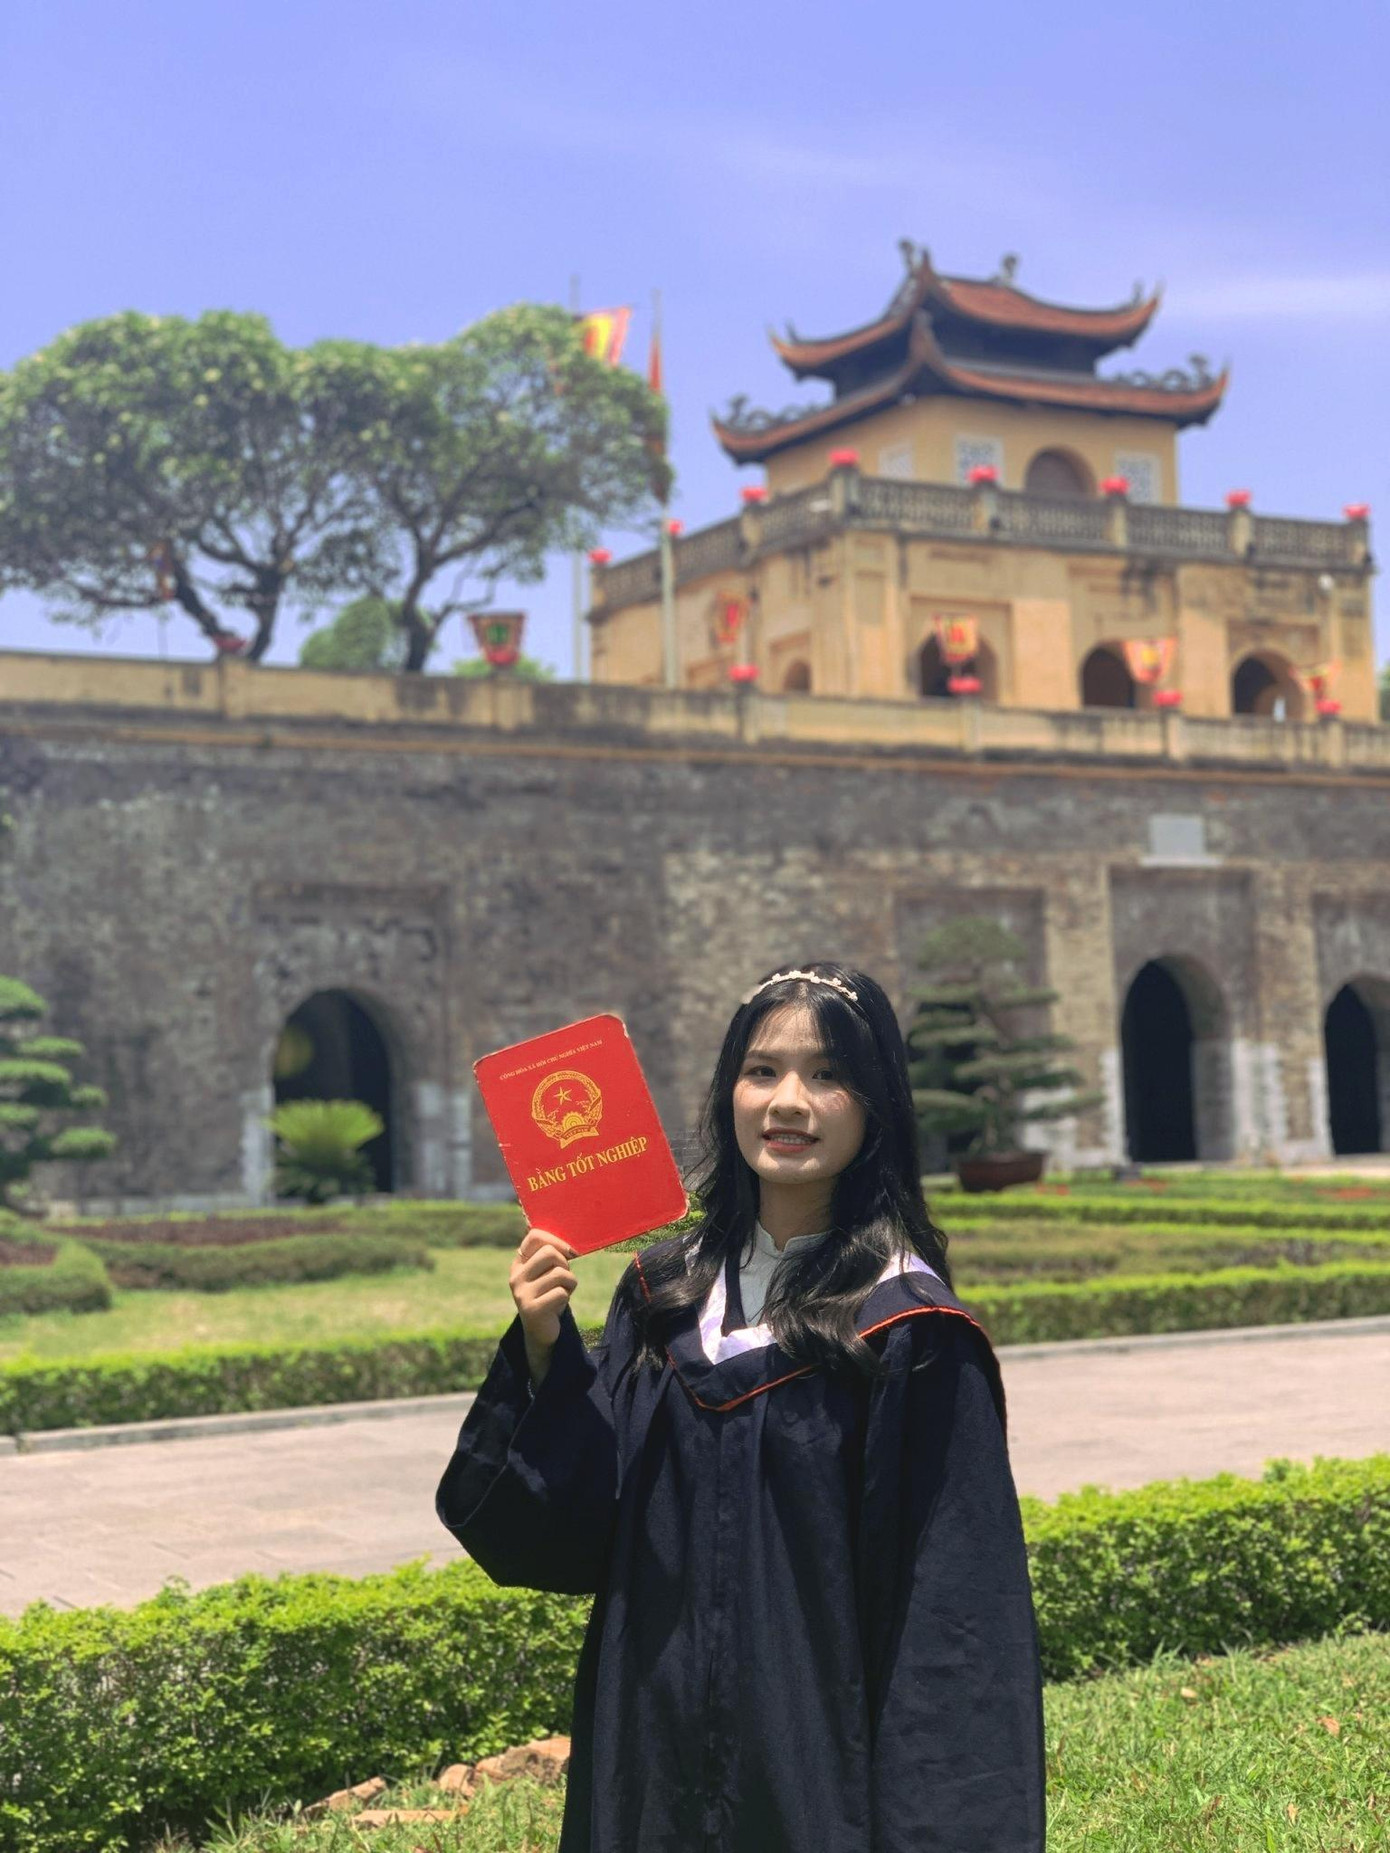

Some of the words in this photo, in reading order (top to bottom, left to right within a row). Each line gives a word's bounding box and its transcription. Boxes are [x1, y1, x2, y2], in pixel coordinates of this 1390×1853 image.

[527, 1167, 567, 1192] BẰNG
[566, 1152, 595, 1178] TỐT
[595, 1136, 647, 1167] NGHIỆP
